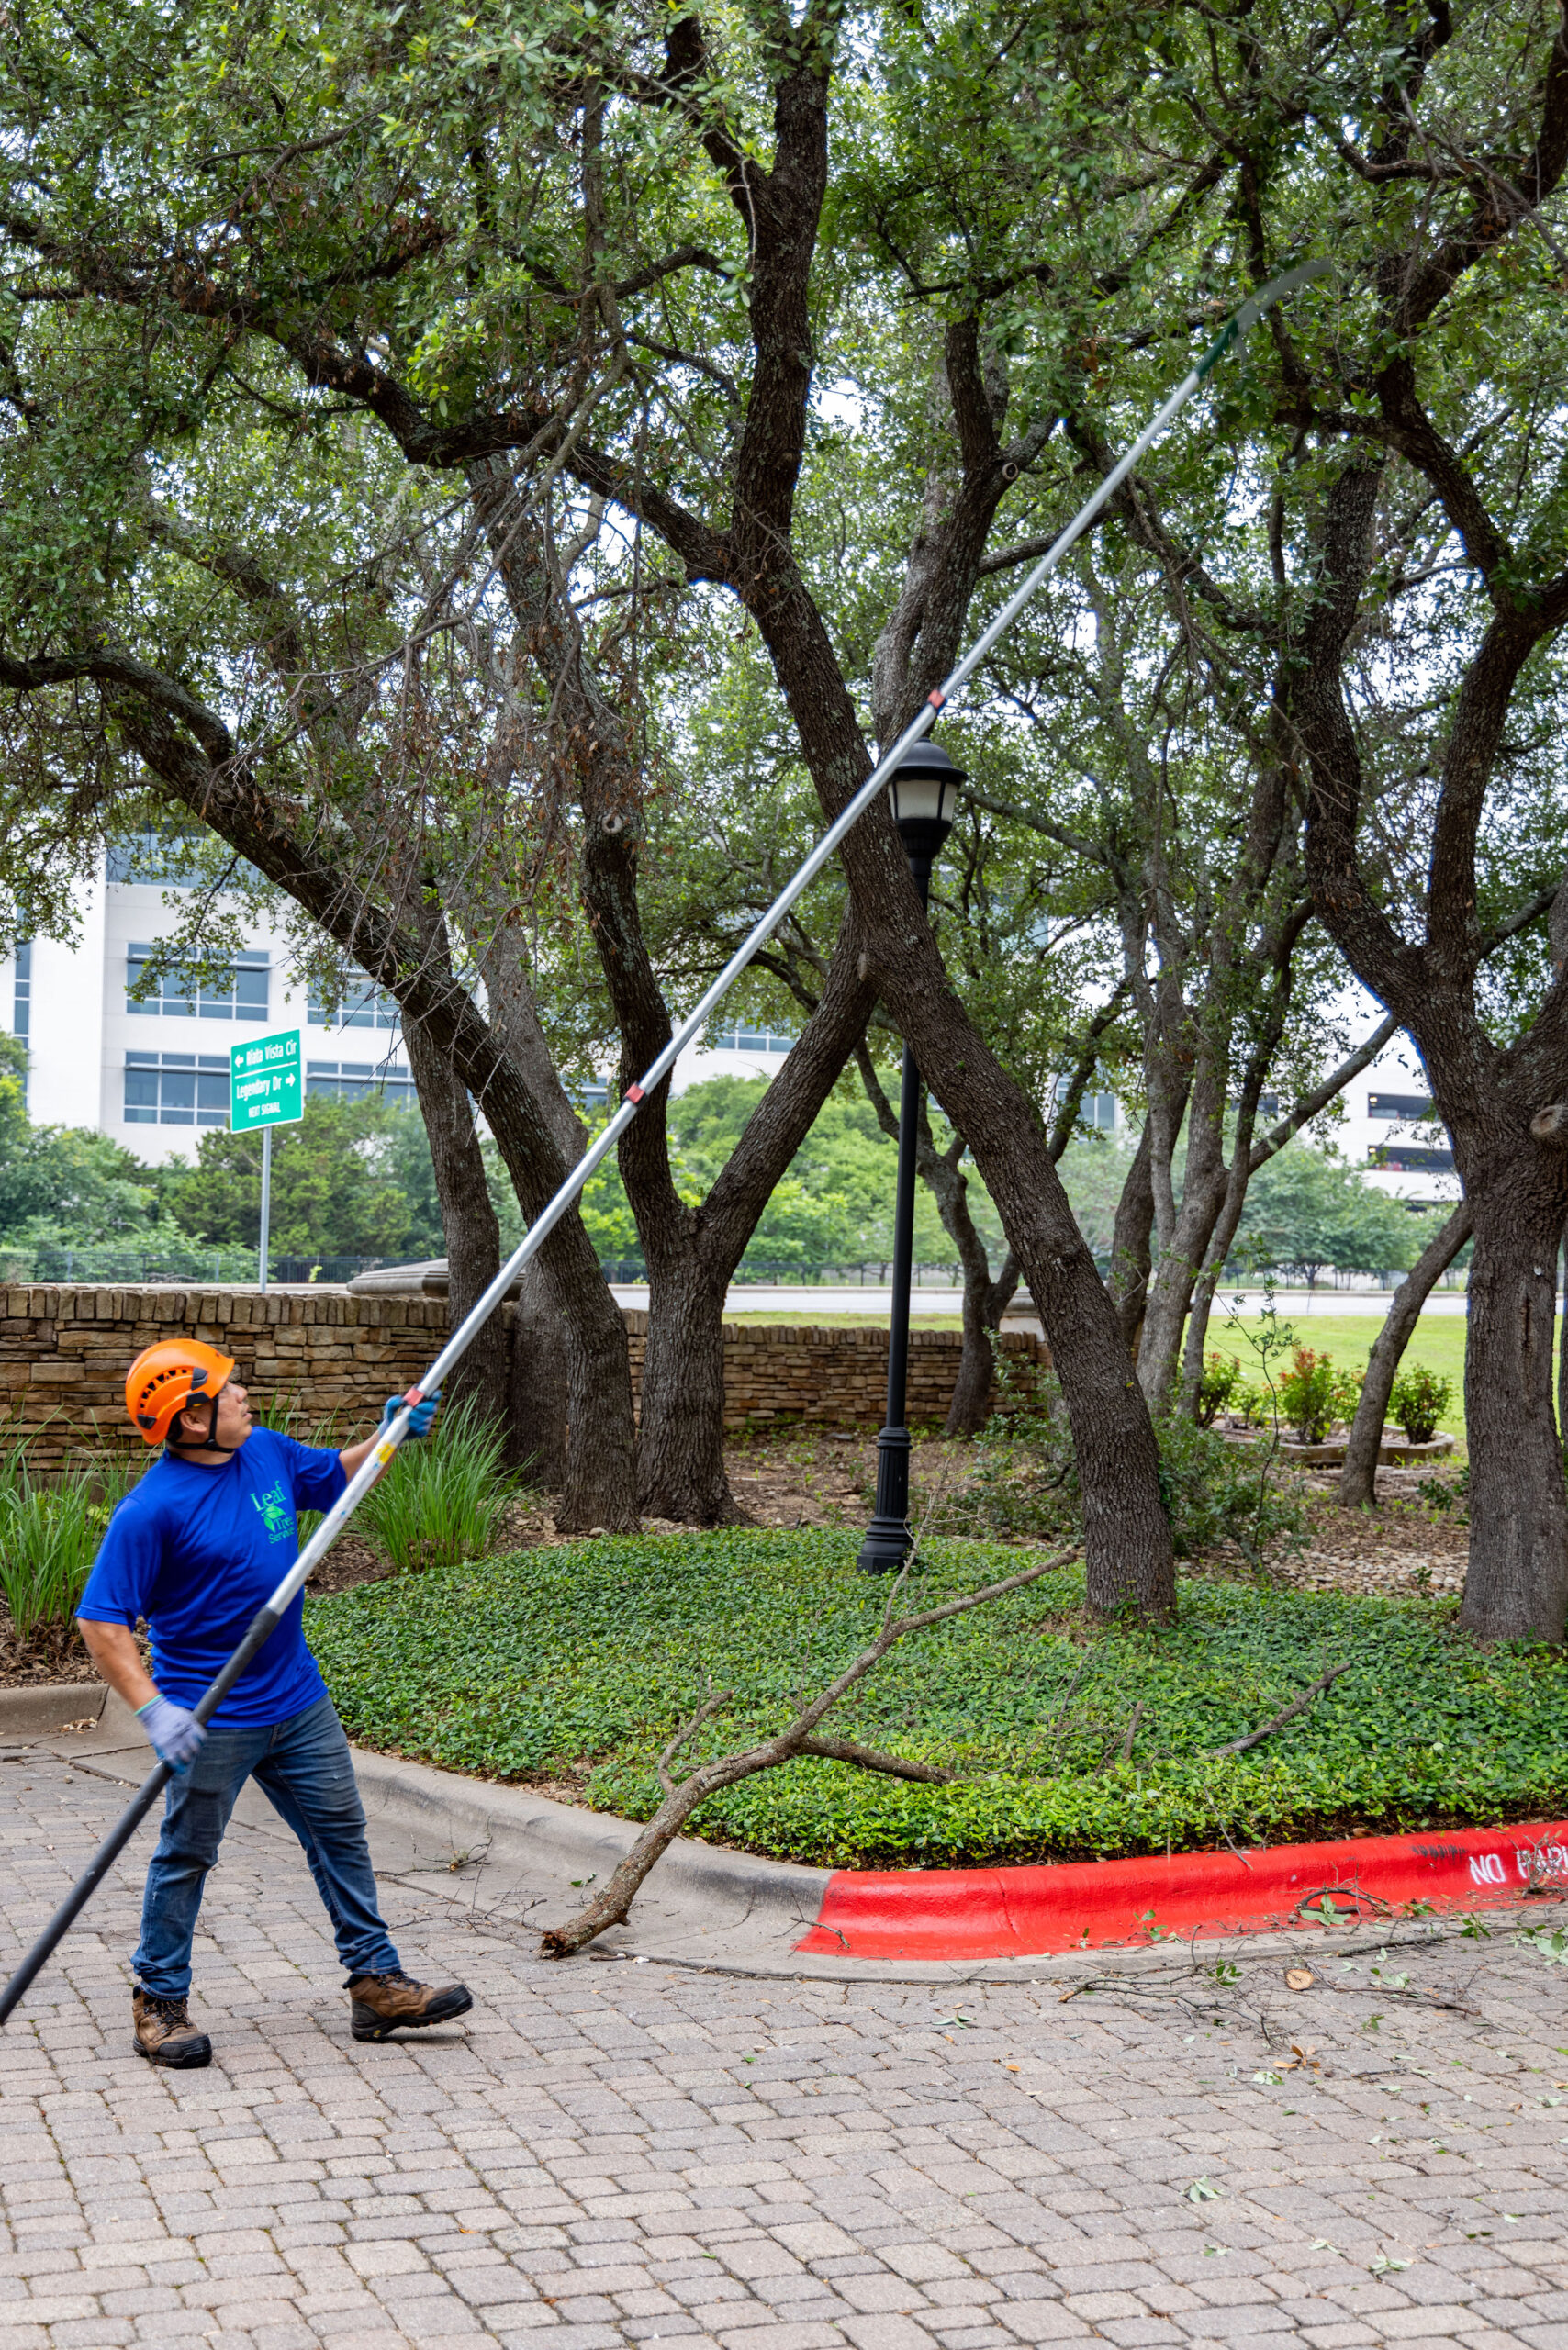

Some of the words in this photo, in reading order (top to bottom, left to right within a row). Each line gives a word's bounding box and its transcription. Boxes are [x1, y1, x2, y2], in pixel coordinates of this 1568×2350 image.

[246, 1048, 263, 1066] Riata
[264, 1044, 284, 1059] Vista
[286, 1039, 297, 1056] Cir
[237, 1079, 271, 1101] Legendary
[272, 1076, 282, 1091] Dr
[248, 1105, 261, 1118] NEXT
[261, 1102, 281, 1115] SIGNAL
[249, 1480, 287, 1512] Leaf
[1469, 1854, 1506, 1885] NO
